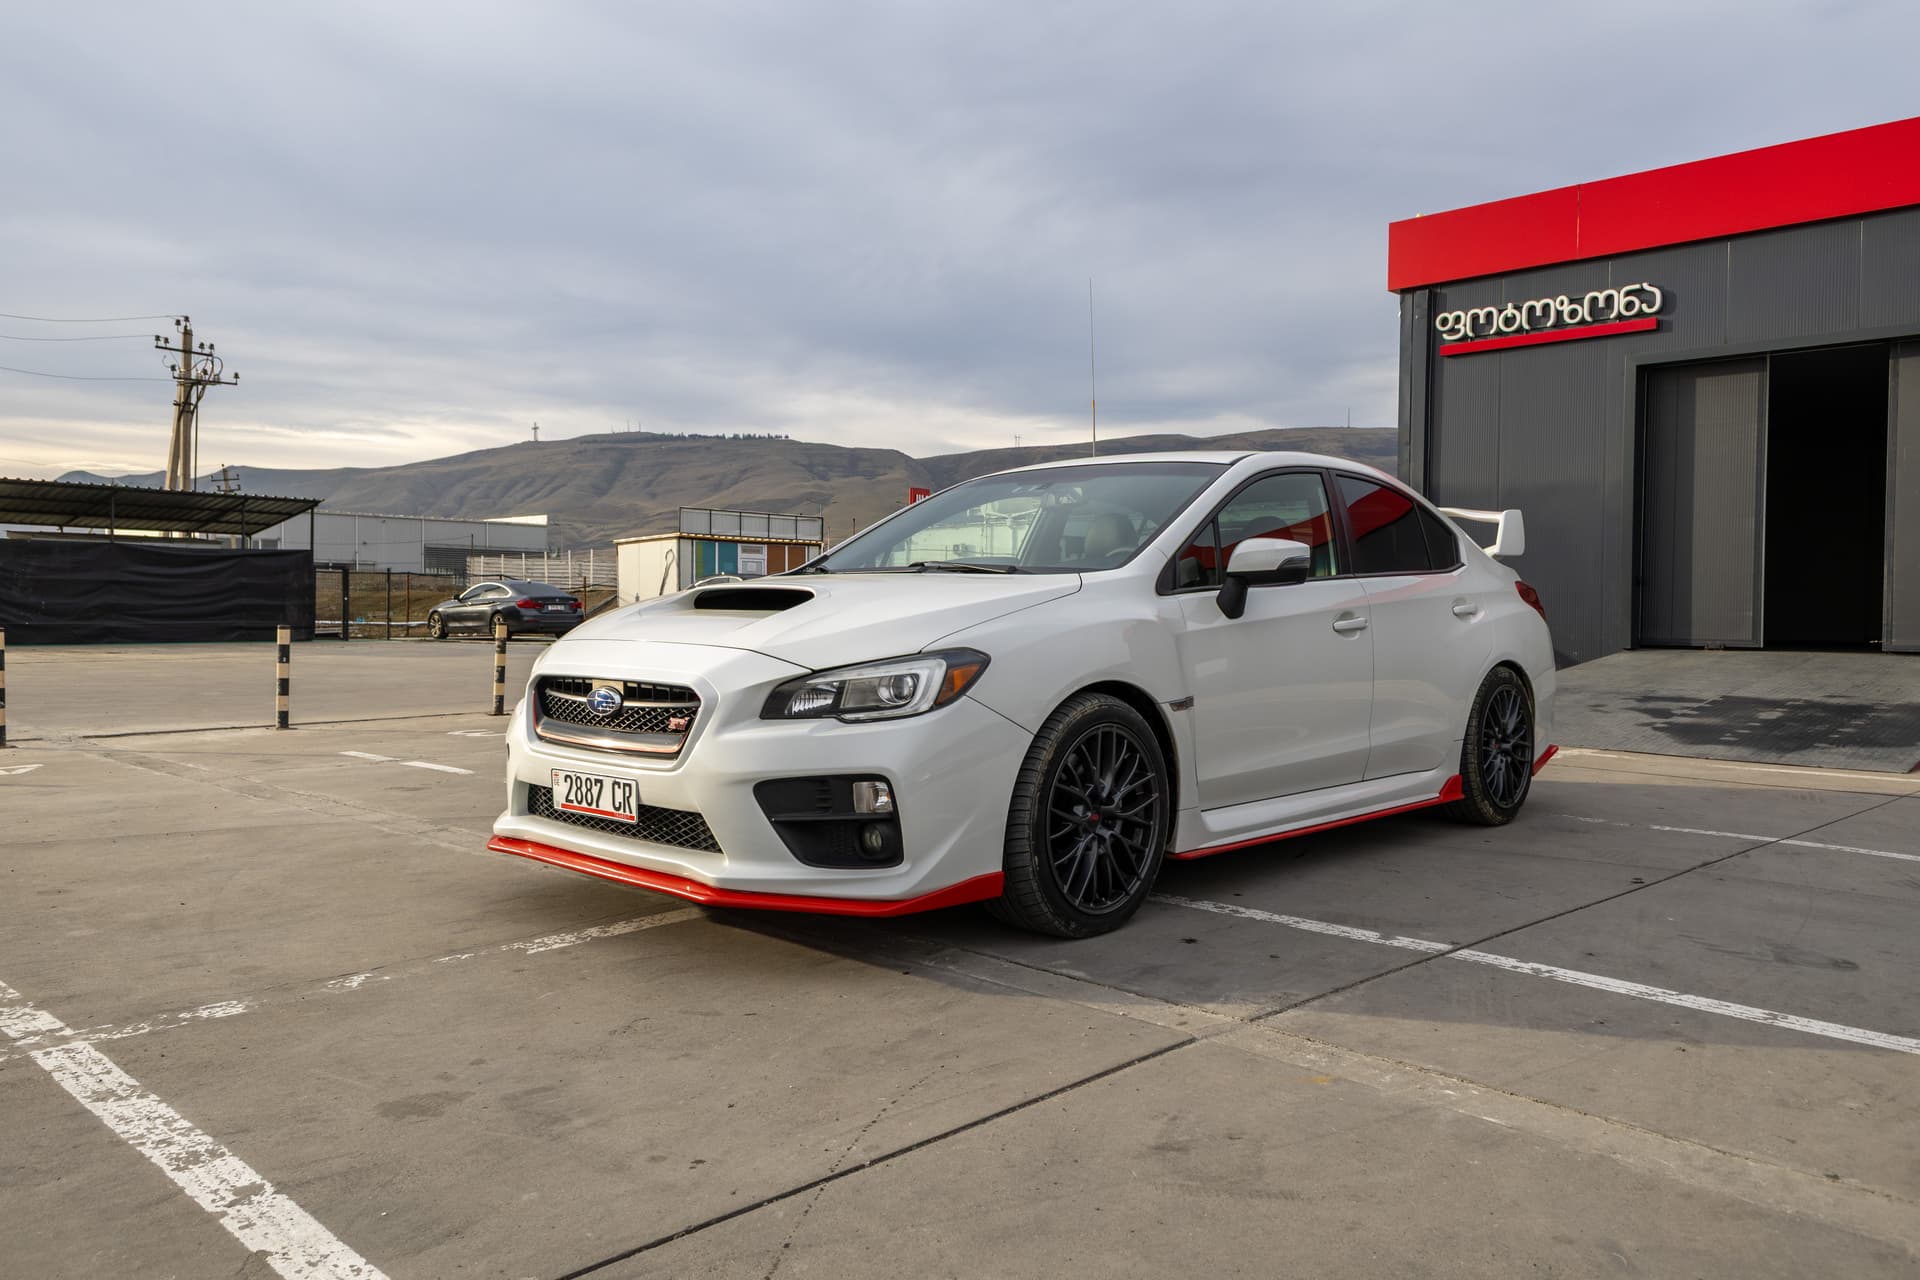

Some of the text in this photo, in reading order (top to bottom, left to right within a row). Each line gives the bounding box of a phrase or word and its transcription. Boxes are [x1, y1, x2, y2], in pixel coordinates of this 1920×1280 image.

[1435, 281, 1662, 341] ფოტოზონა
[564, 774, 633, 815] 2887 CR
